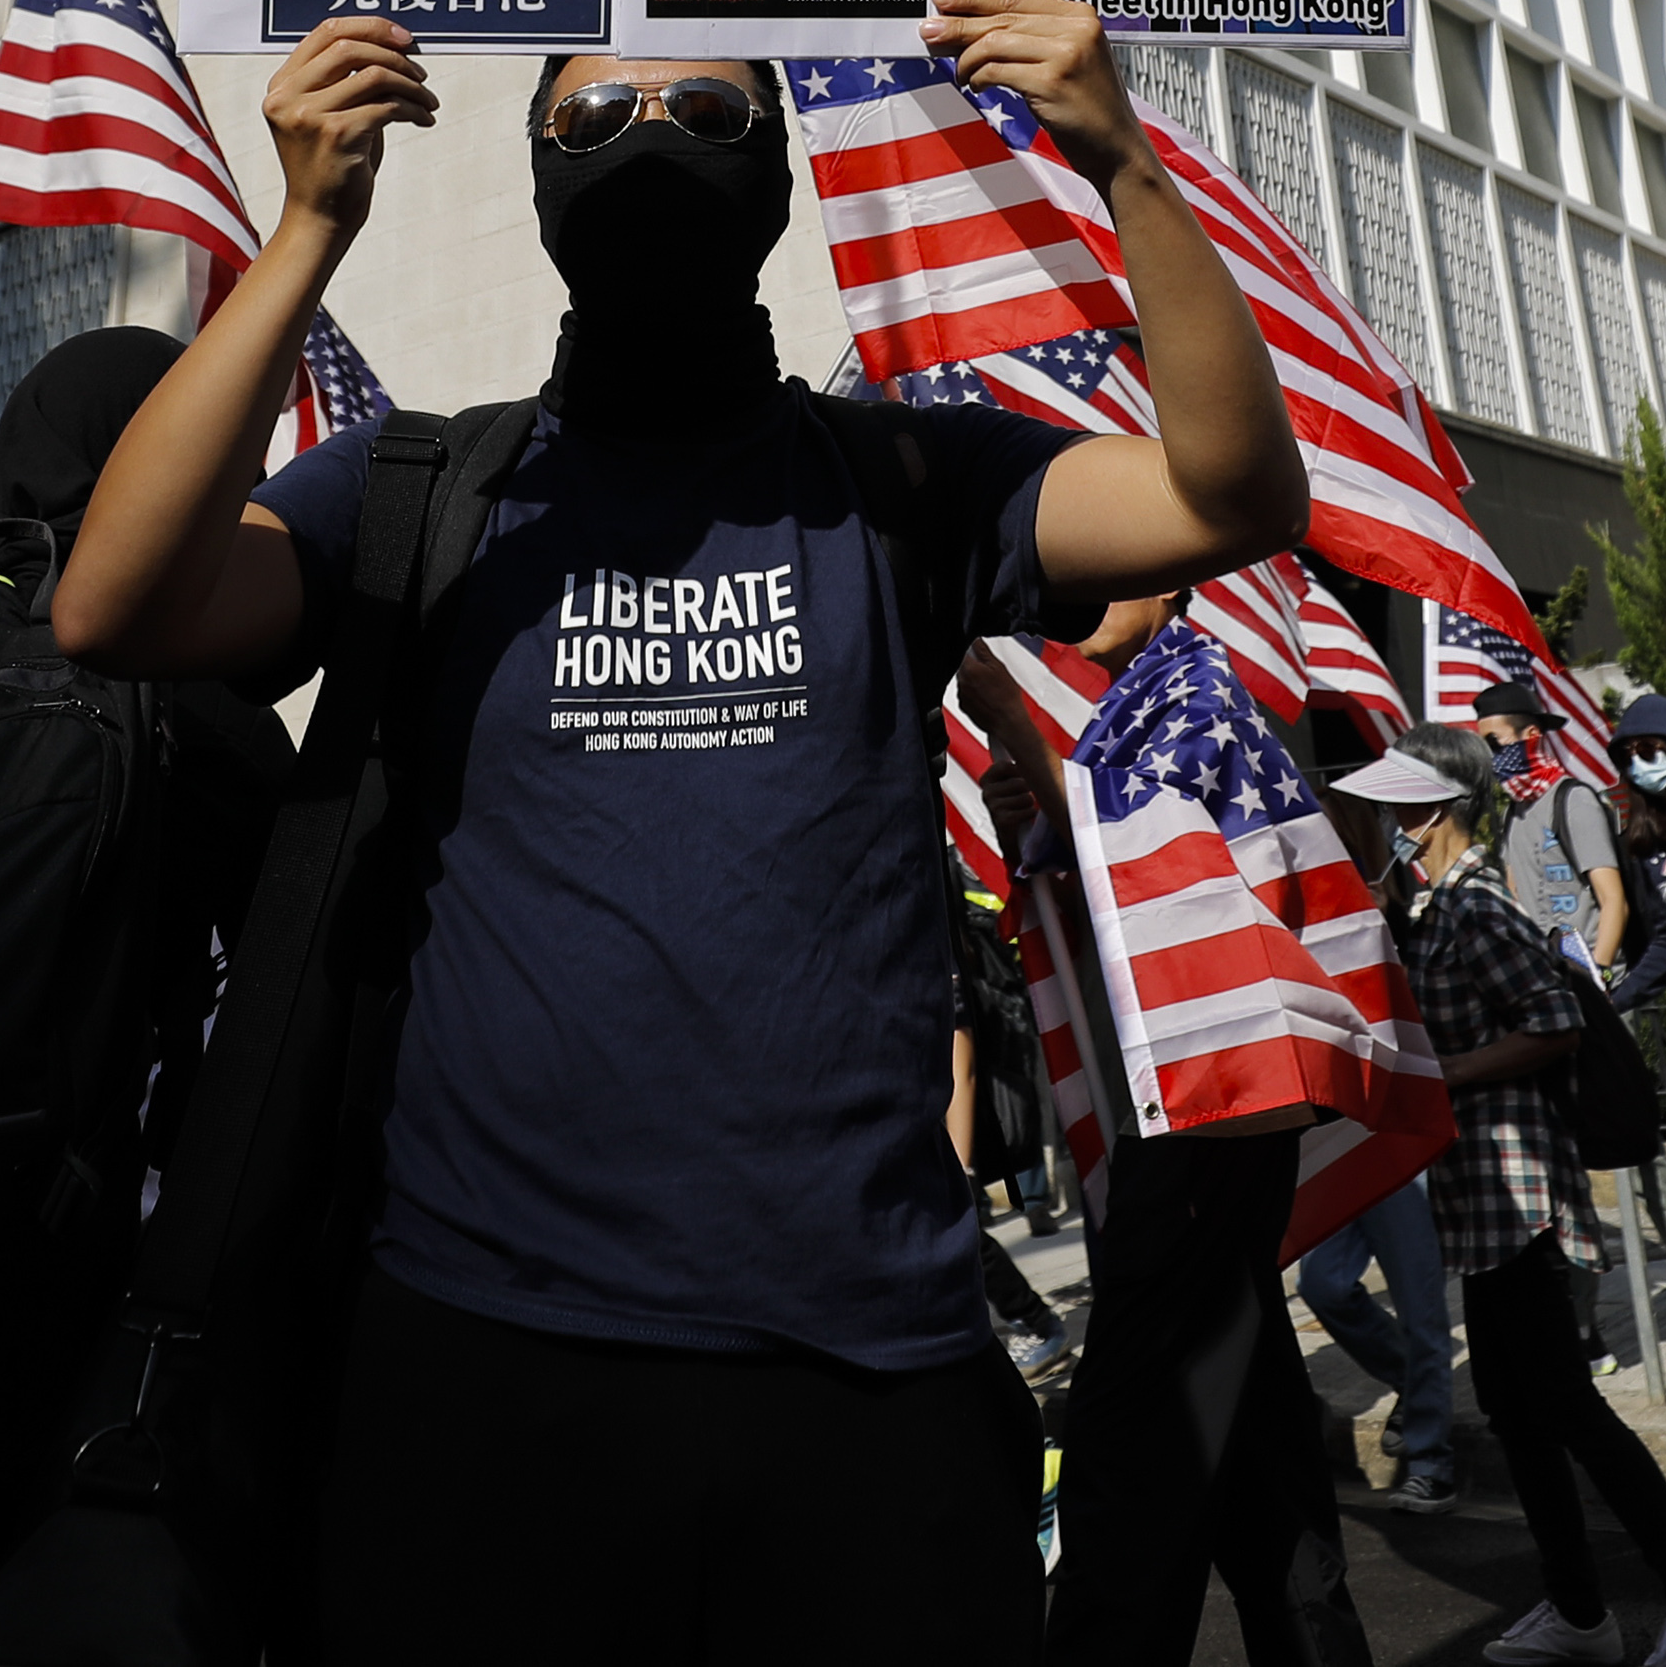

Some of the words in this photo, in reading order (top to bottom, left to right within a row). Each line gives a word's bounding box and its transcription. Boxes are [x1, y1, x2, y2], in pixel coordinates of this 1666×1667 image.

[559, 563, 797, 634] LIBERATE
[554, 634, 672, 688] HONG
[686, 624, 803, 684] KONG
[550, 710, 600, 730] DEFEND
[602, 709, 629, 727] OUR
[630, 706, 718, 728] CONSTITUTION
[720, 707, 732, 724] &
[734, 703, 761, 722] WAY
[763, 701, 779, 720] OF
[781, 699, 808, 718] LIFE
[585, 732, 620, 752] HONG
[622, 731, 658, 750] KONG
[660, 729, 728, 750] AUTONOMY
[730, 726, 775, 747] ACTION
